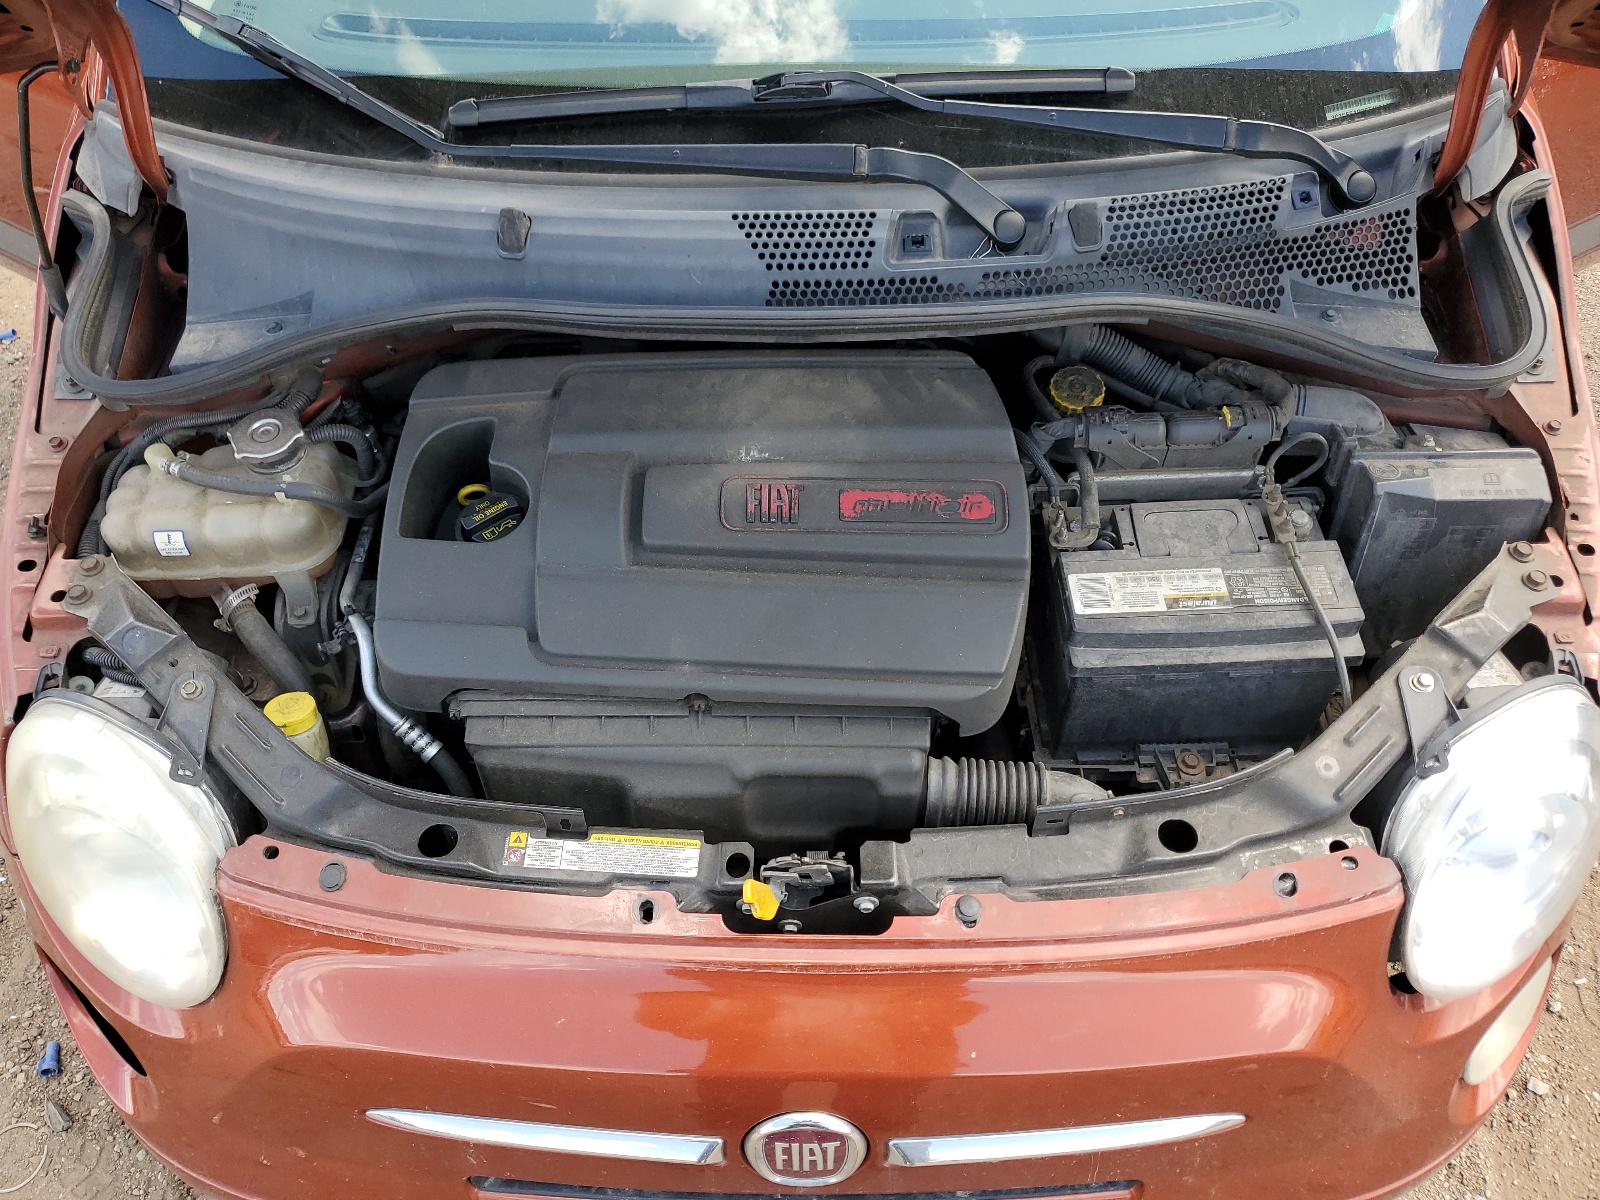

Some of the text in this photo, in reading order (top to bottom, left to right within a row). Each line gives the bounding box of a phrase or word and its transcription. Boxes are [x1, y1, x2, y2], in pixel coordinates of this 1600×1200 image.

[1459, 489, 1476, 497] FUSE
[1479, 489, 1491, 497] AND
[1494, 488, 1514, 496] RELAY
[475, 500, 490, 511] ONLY
[745, 483, 804, 523] FIAT
[472, 501, 508, 521] ENGINE OIL
[1177, 599, 1217, 609] Duralast
[774, 1141, 841, 1172] FIAT
